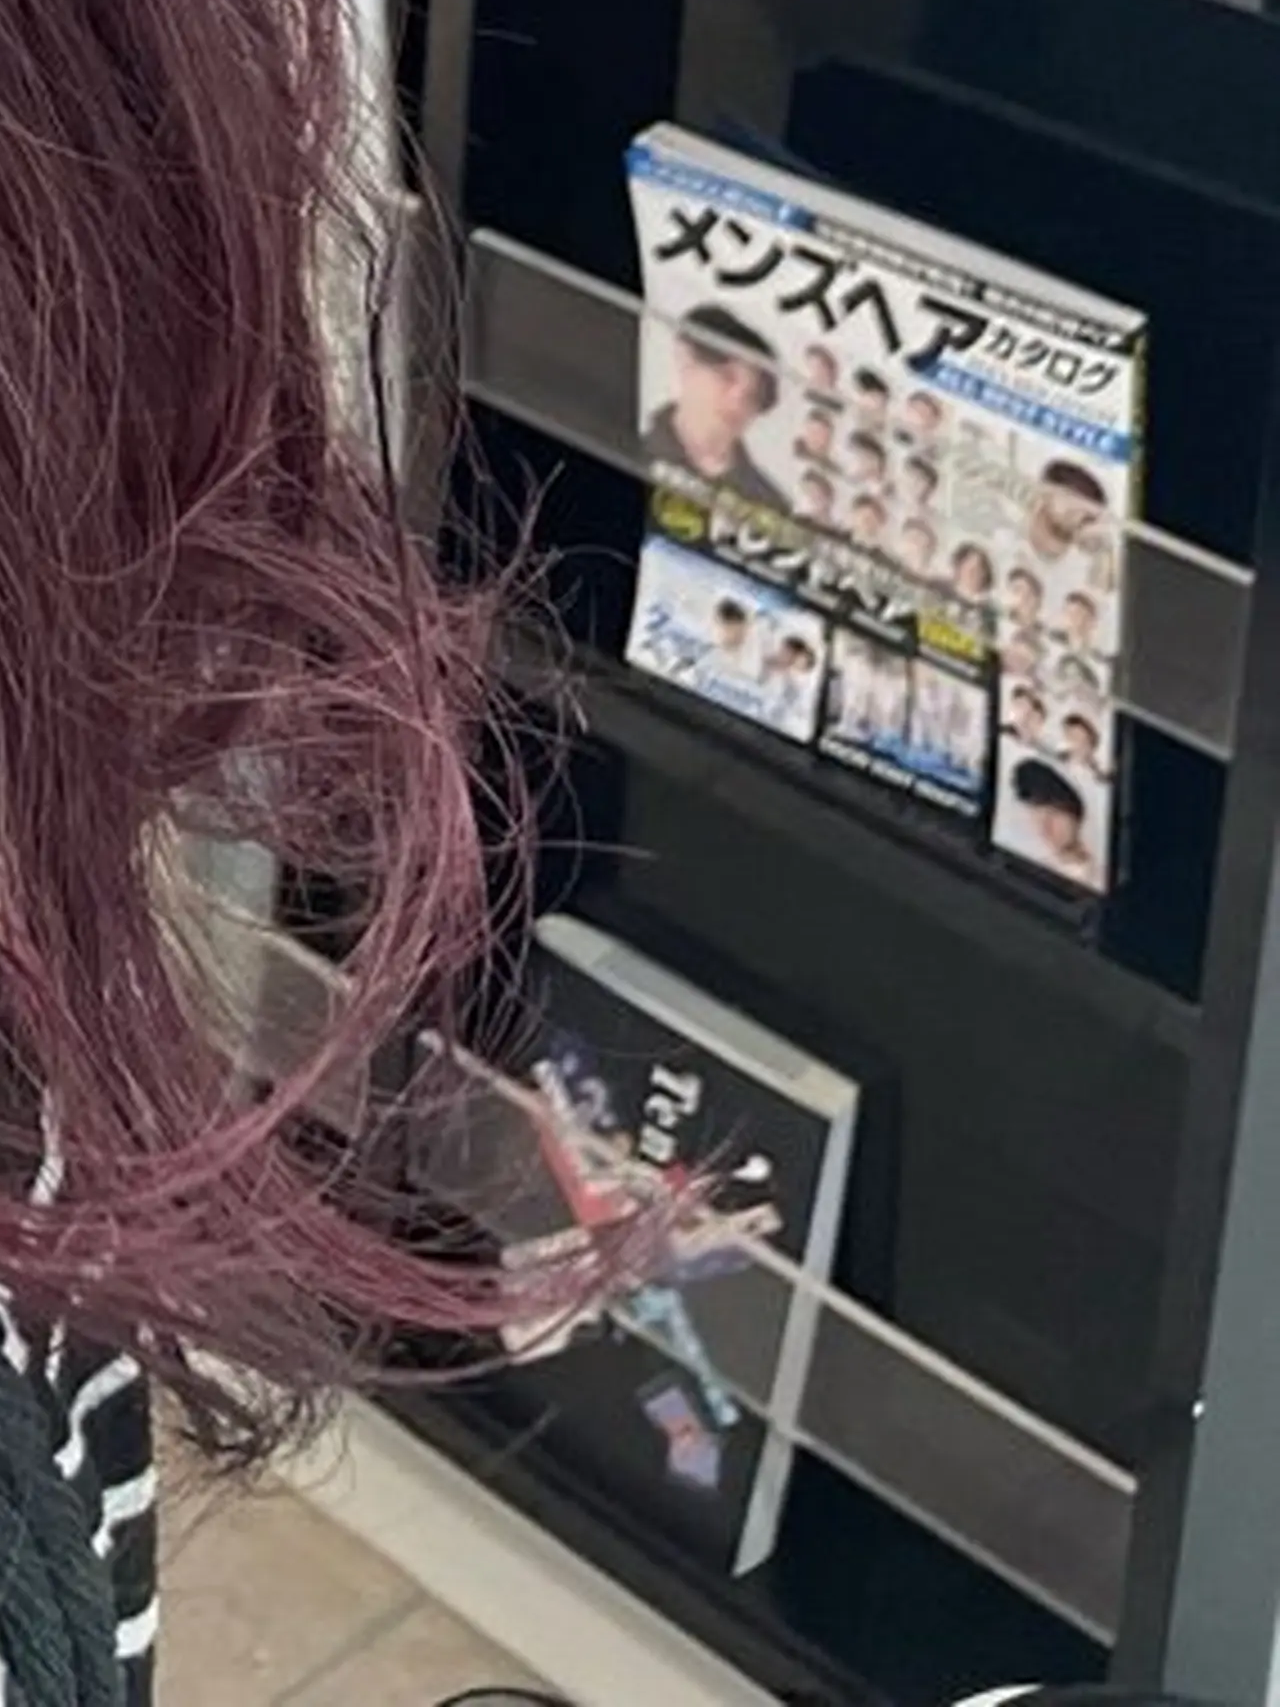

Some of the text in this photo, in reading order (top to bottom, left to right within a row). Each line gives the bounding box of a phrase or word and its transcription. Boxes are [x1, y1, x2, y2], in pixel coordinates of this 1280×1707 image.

[653, 205, 990, 379] メンズヘア
[984, 325, 1120, 395] カタログ
